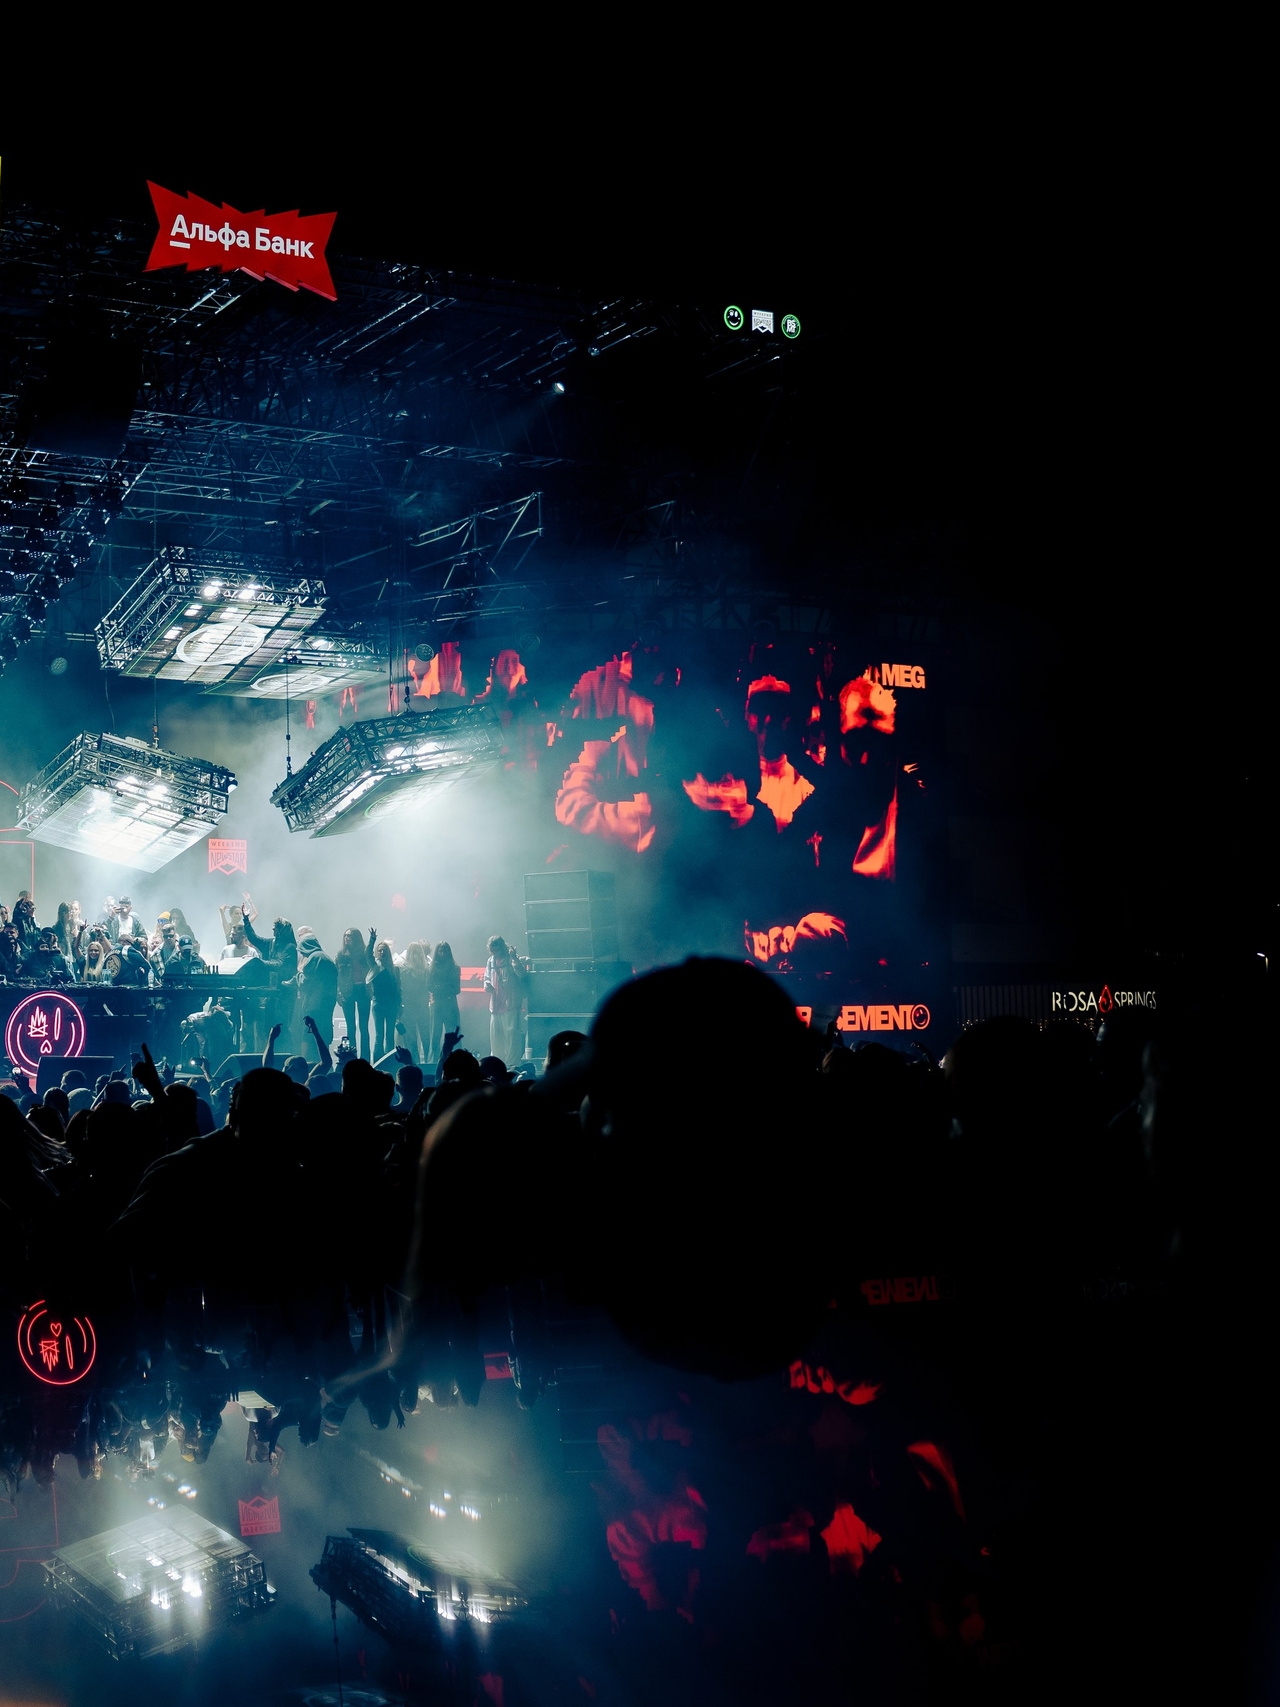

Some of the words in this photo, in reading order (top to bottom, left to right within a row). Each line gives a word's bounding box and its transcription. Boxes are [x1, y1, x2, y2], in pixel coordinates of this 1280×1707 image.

[170, 214, 251, 251] Альфа
[255, 227, 315, 259] Банк
[881, 662, 926, 689] MEG
